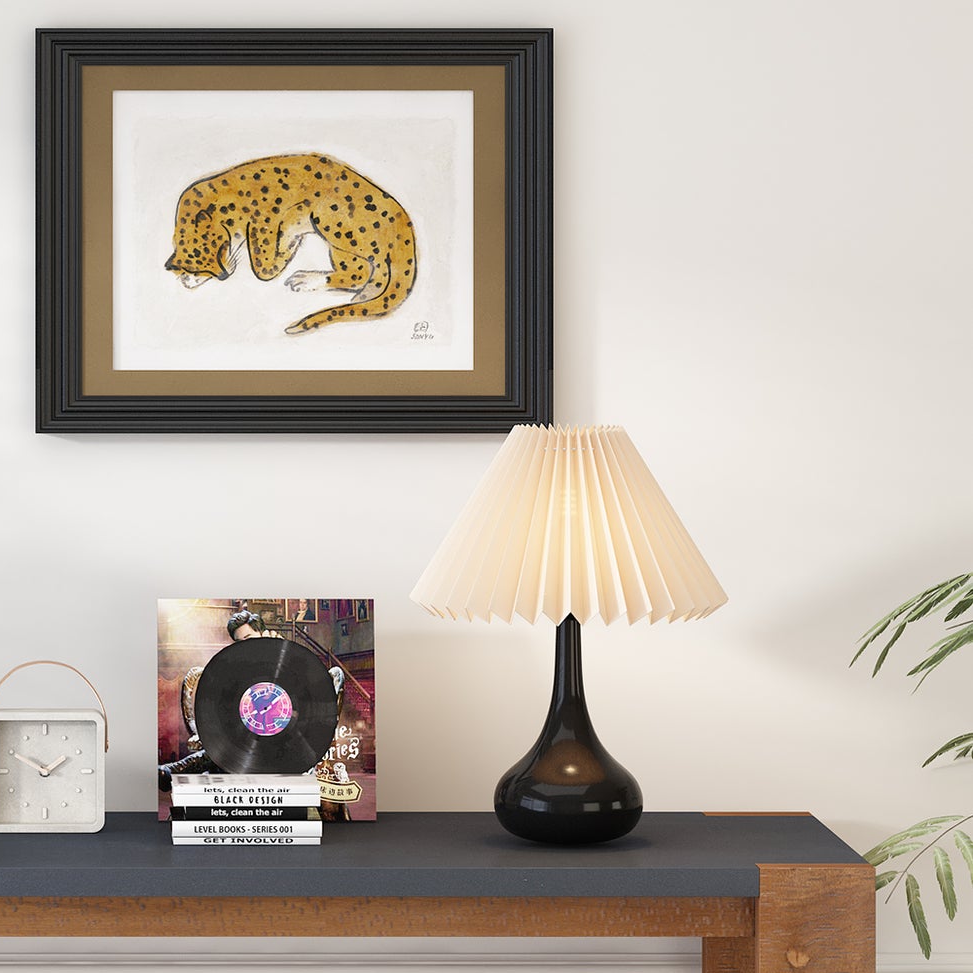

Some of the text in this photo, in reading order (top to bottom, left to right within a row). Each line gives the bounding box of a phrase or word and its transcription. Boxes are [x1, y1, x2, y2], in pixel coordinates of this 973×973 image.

[213, 795, 284, 805] BLACK DESIGN
[210, 808, 283, 818] lets, clean the air
[193, 825, 217, 834] LEVEL
[218, 825, 246, 834] BOOKS
[251, 825, 278, 834] SERIES
[279, 825, 293, 834] 001
